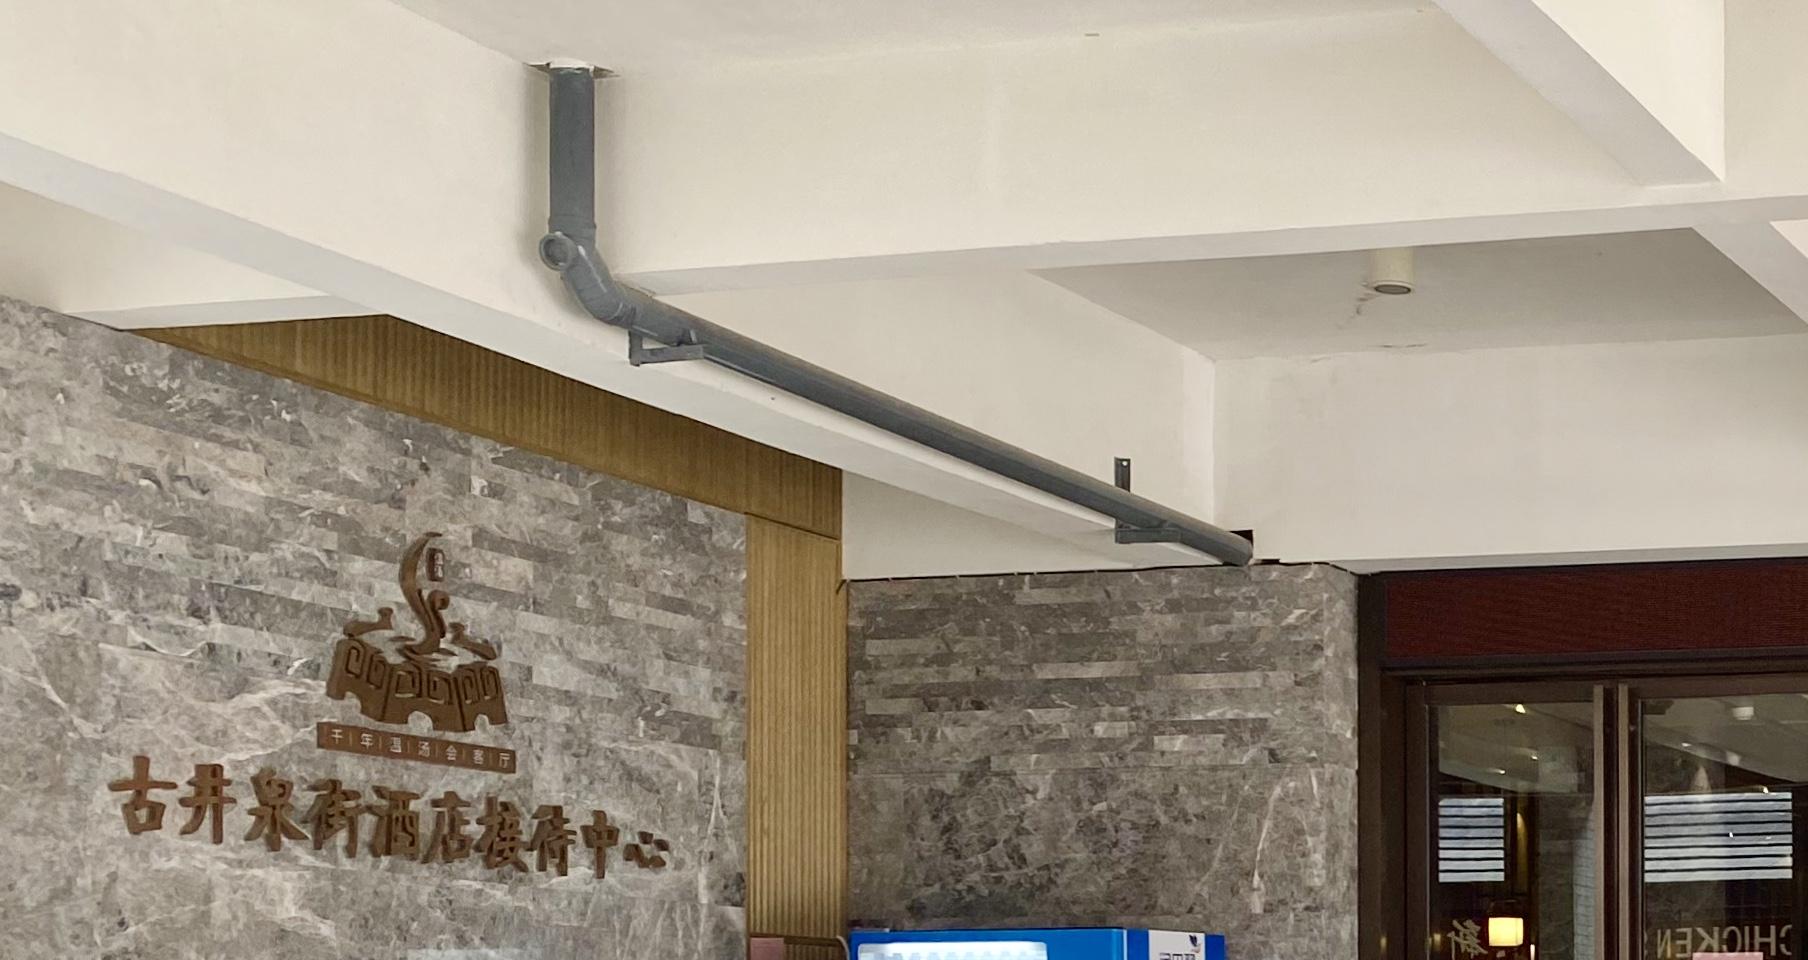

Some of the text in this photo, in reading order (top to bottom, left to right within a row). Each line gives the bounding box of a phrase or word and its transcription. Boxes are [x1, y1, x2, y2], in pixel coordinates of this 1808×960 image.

[330, 728, 511, 769] 千年温汤会客厅
[107, 755, 669, 879] 古井泉街酒店接待中心
